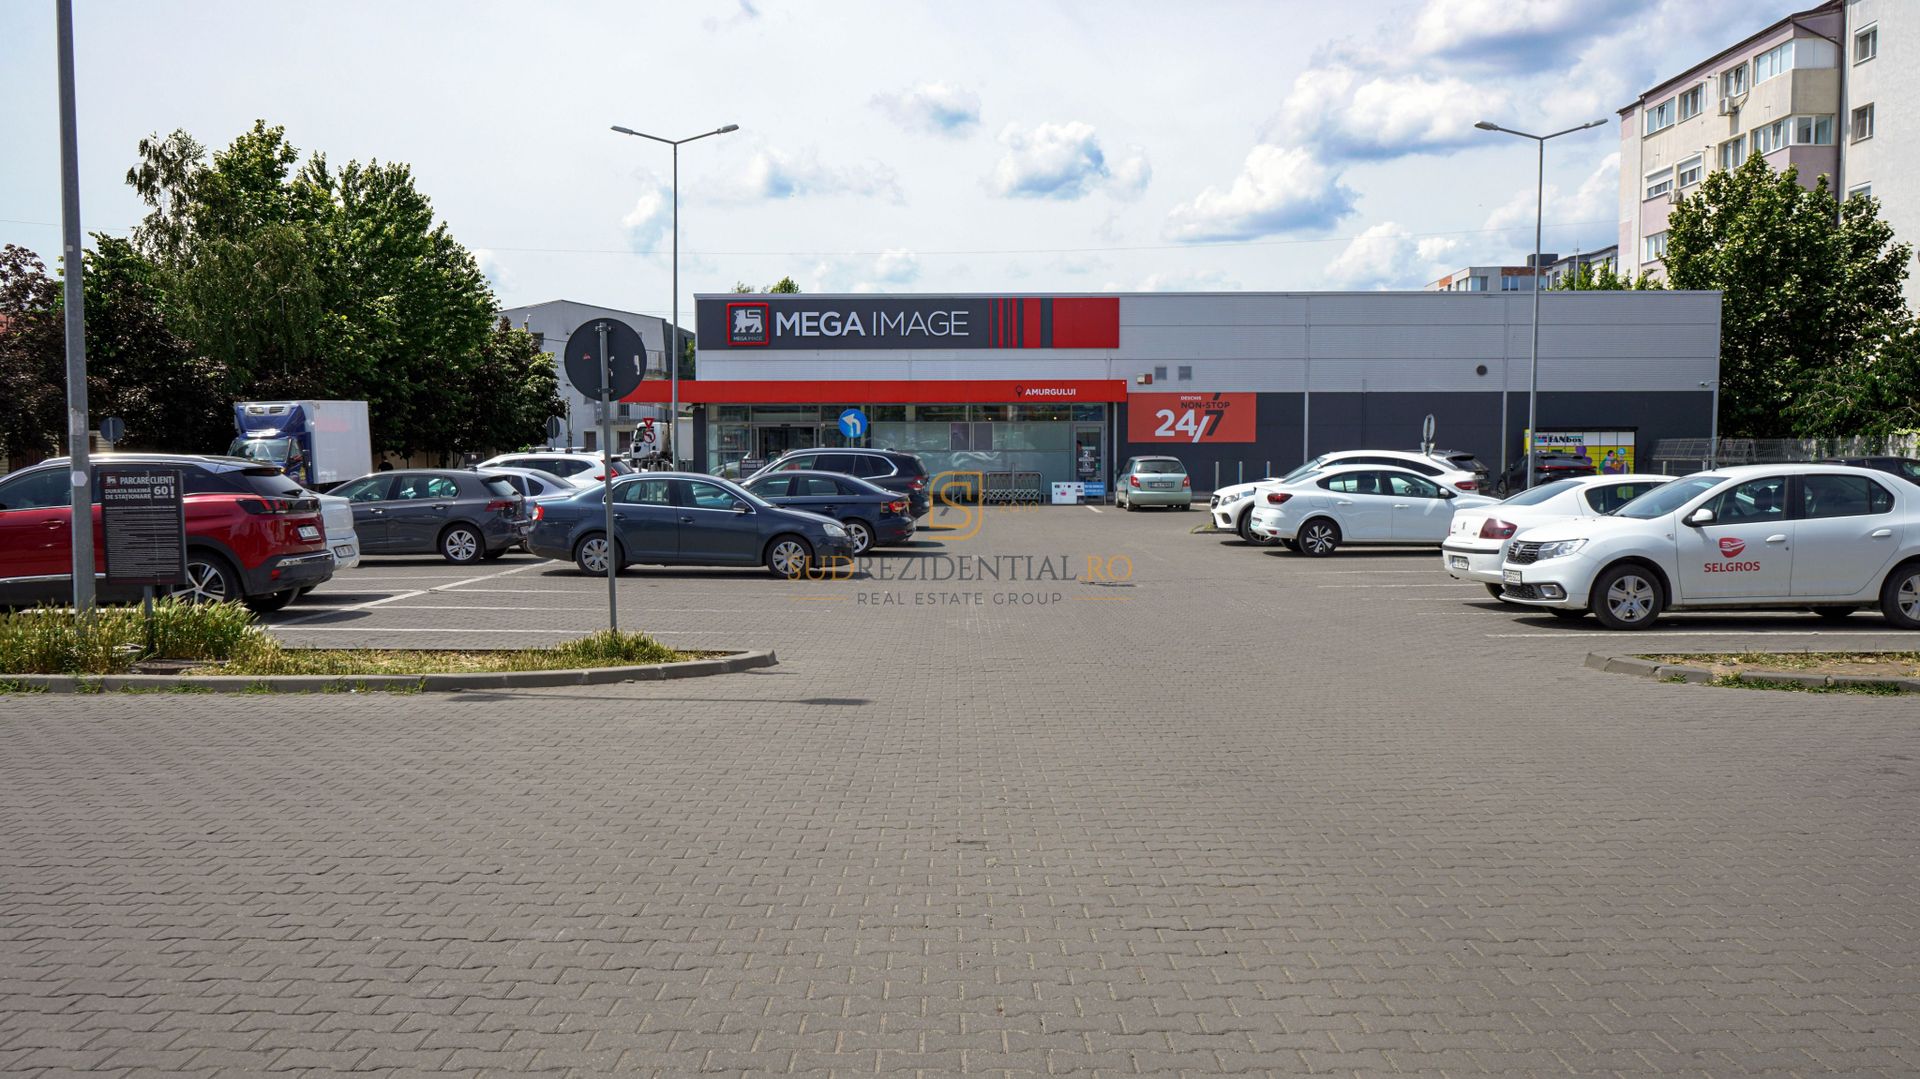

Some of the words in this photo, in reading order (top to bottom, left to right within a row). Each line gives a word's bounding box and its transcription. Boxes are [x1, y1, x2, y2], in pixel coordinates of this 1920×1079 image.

[775, 311, 866, 337] MEGA
[873, 311, 969, 336] IMAGE
[1025, 388, 1077, 396] AMURGULUI
[1180, 401, 1231, 410] NON-STOP
[1154, 409, 1225, 443] 24/7
[119, 476, 149, 485] PARCARE
[153, 486, 169, 495] 60
[1703, 561, 1761, 573] SELGROS
